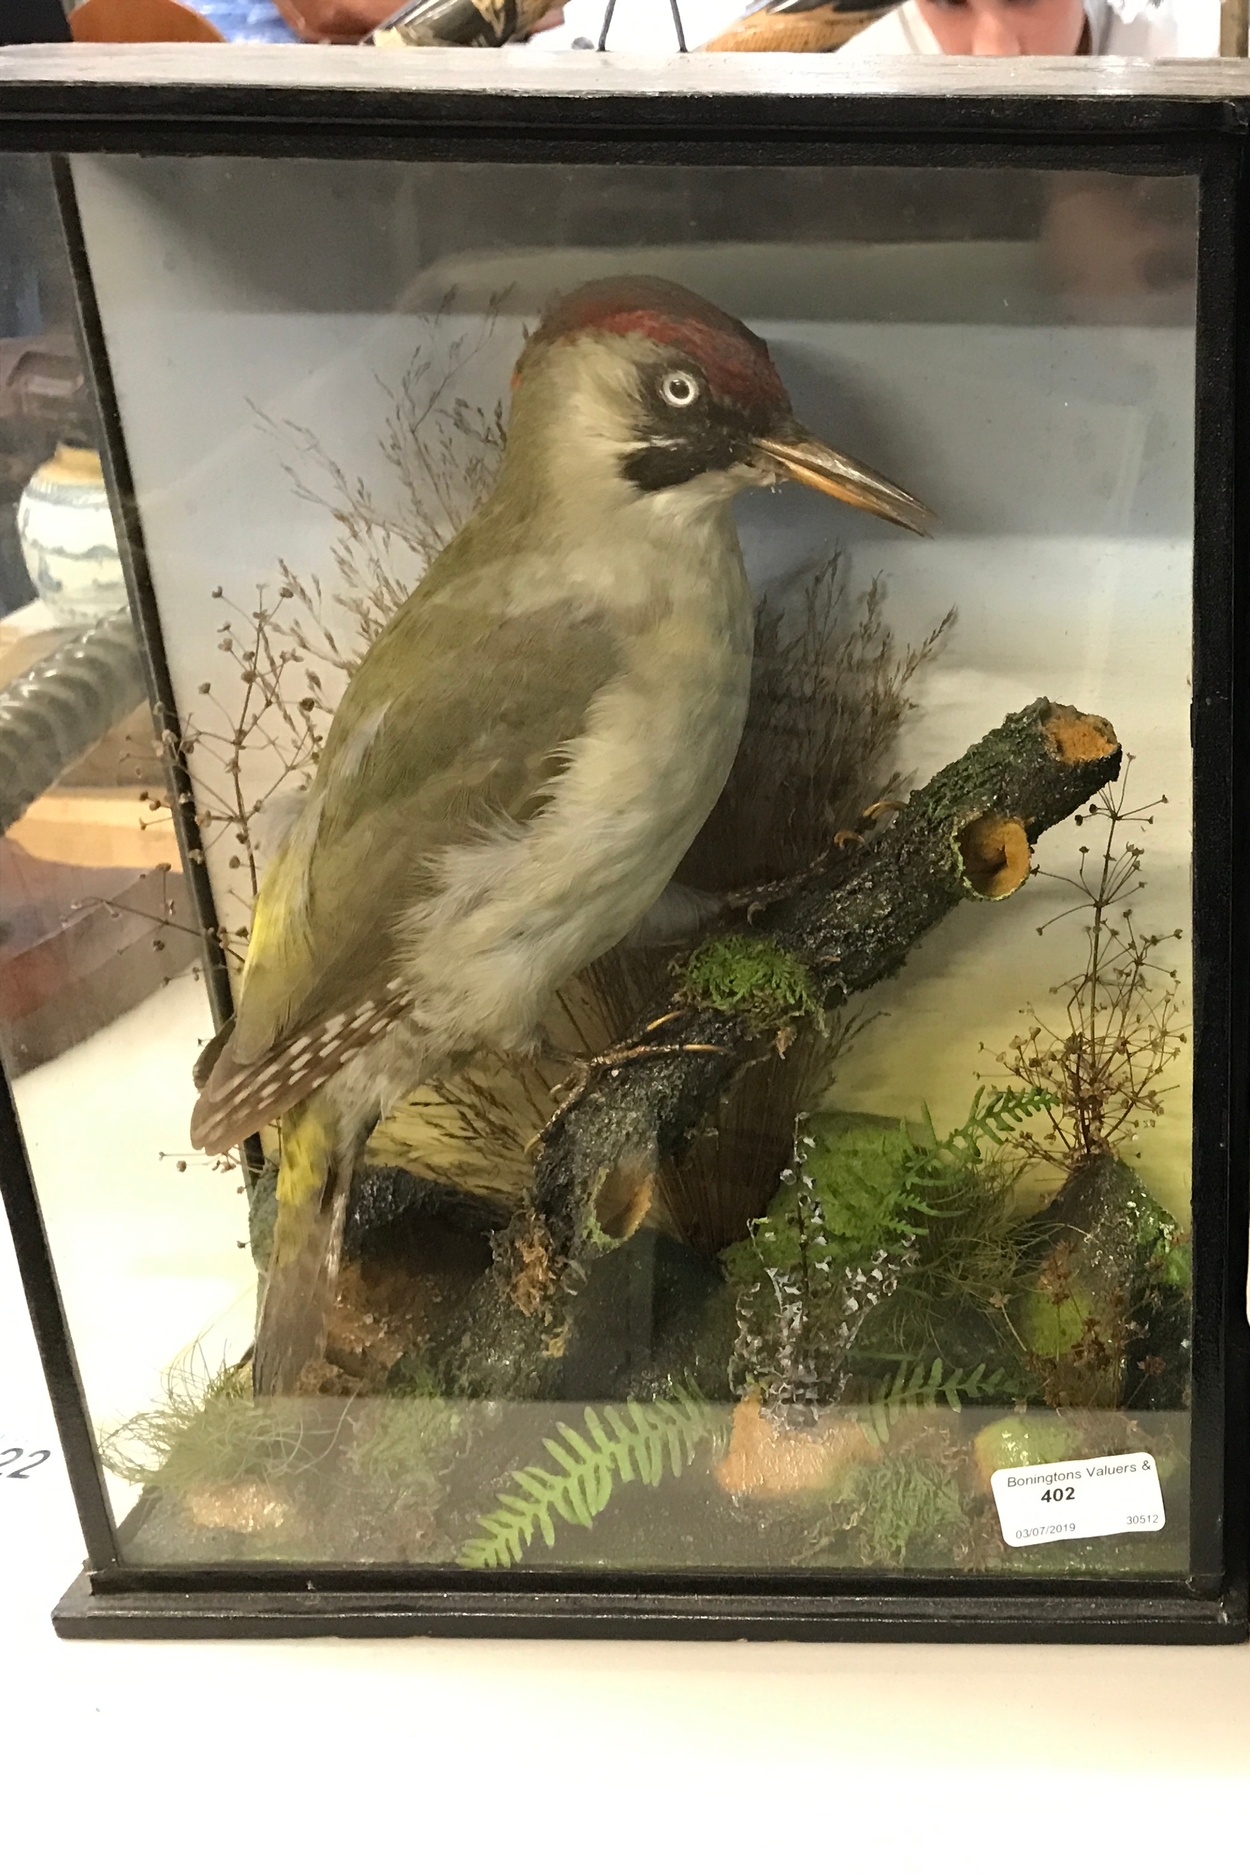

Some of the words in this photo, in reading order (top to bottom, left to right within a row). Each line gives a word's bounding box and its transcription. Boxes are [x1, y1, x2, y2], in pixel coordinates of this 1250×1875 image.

[1007, 1470, 1082, 1487] Boningtons
[1087, 1462, 1137, 1477] Valuers
[1142, 1460, 1151, 1470] &
[1041, 1487, 1075, 1502] 402
[1015, 1523, 1076, 1539] 03/07/2019
[1126, 1514, 1159, 1525] 30512
